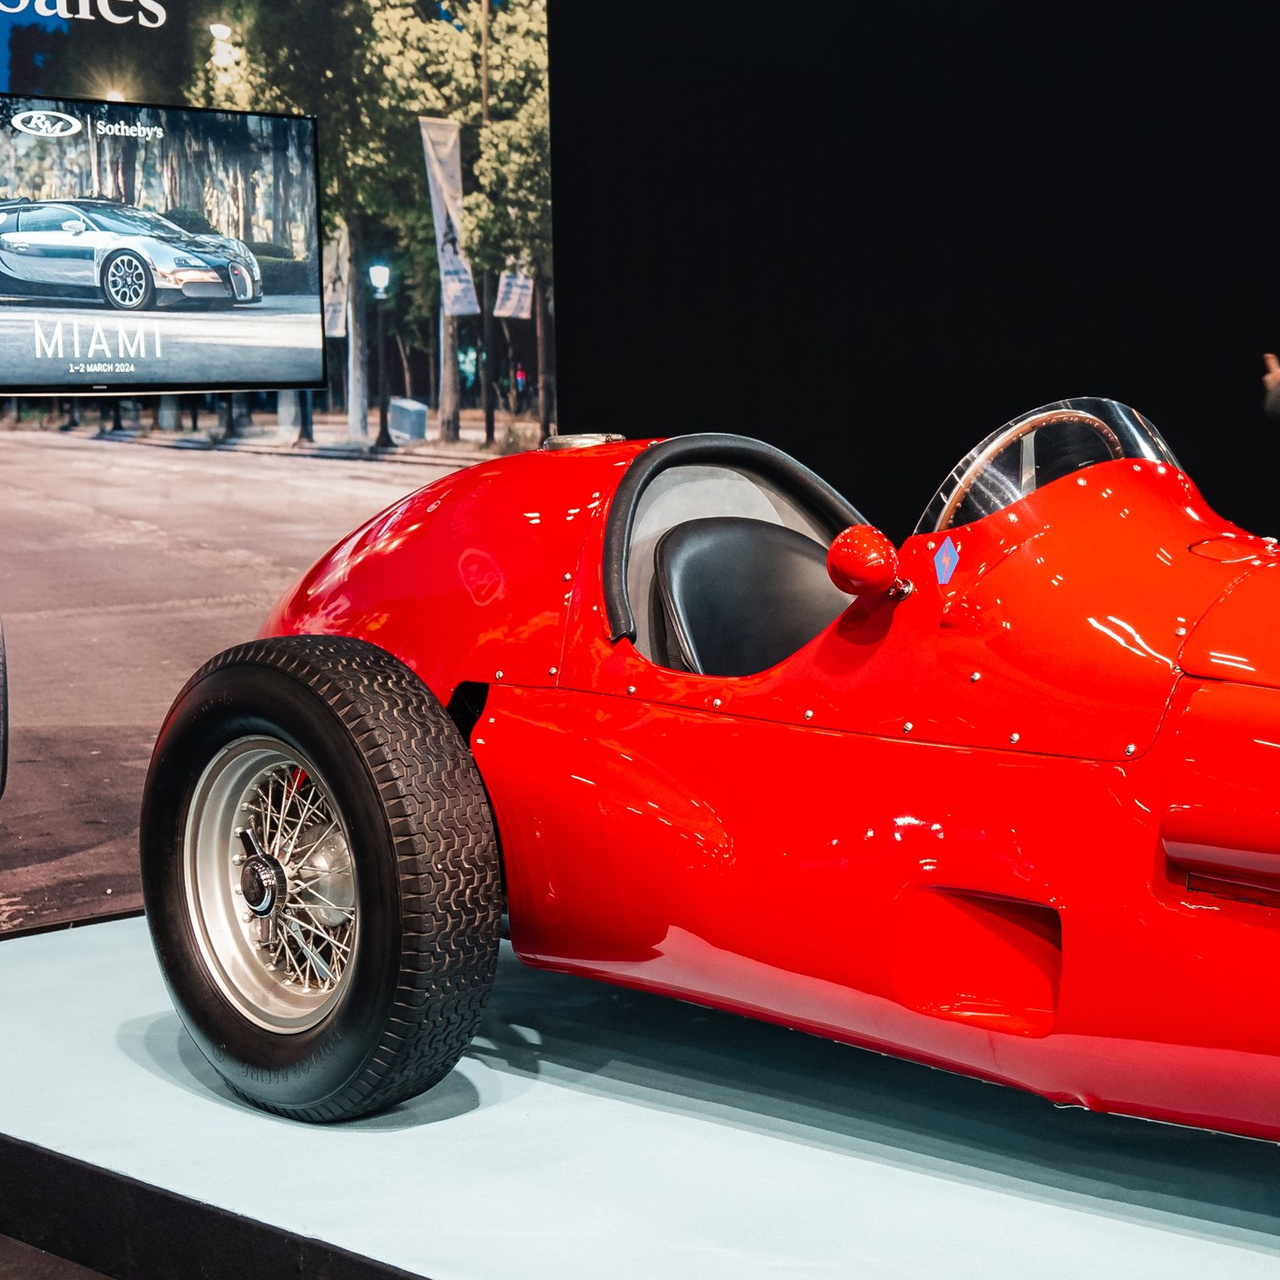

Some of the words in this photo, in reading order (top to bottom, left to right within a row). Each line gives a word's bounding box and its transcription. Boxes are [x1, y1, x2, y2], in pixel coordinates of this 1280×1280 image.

[96, 120, 164, 141] Sotheby's
[34, 319, 162, 359] MIAMI
[86, 363, 114, 373] MARCH
[114, 363, 135, 373] 2024
